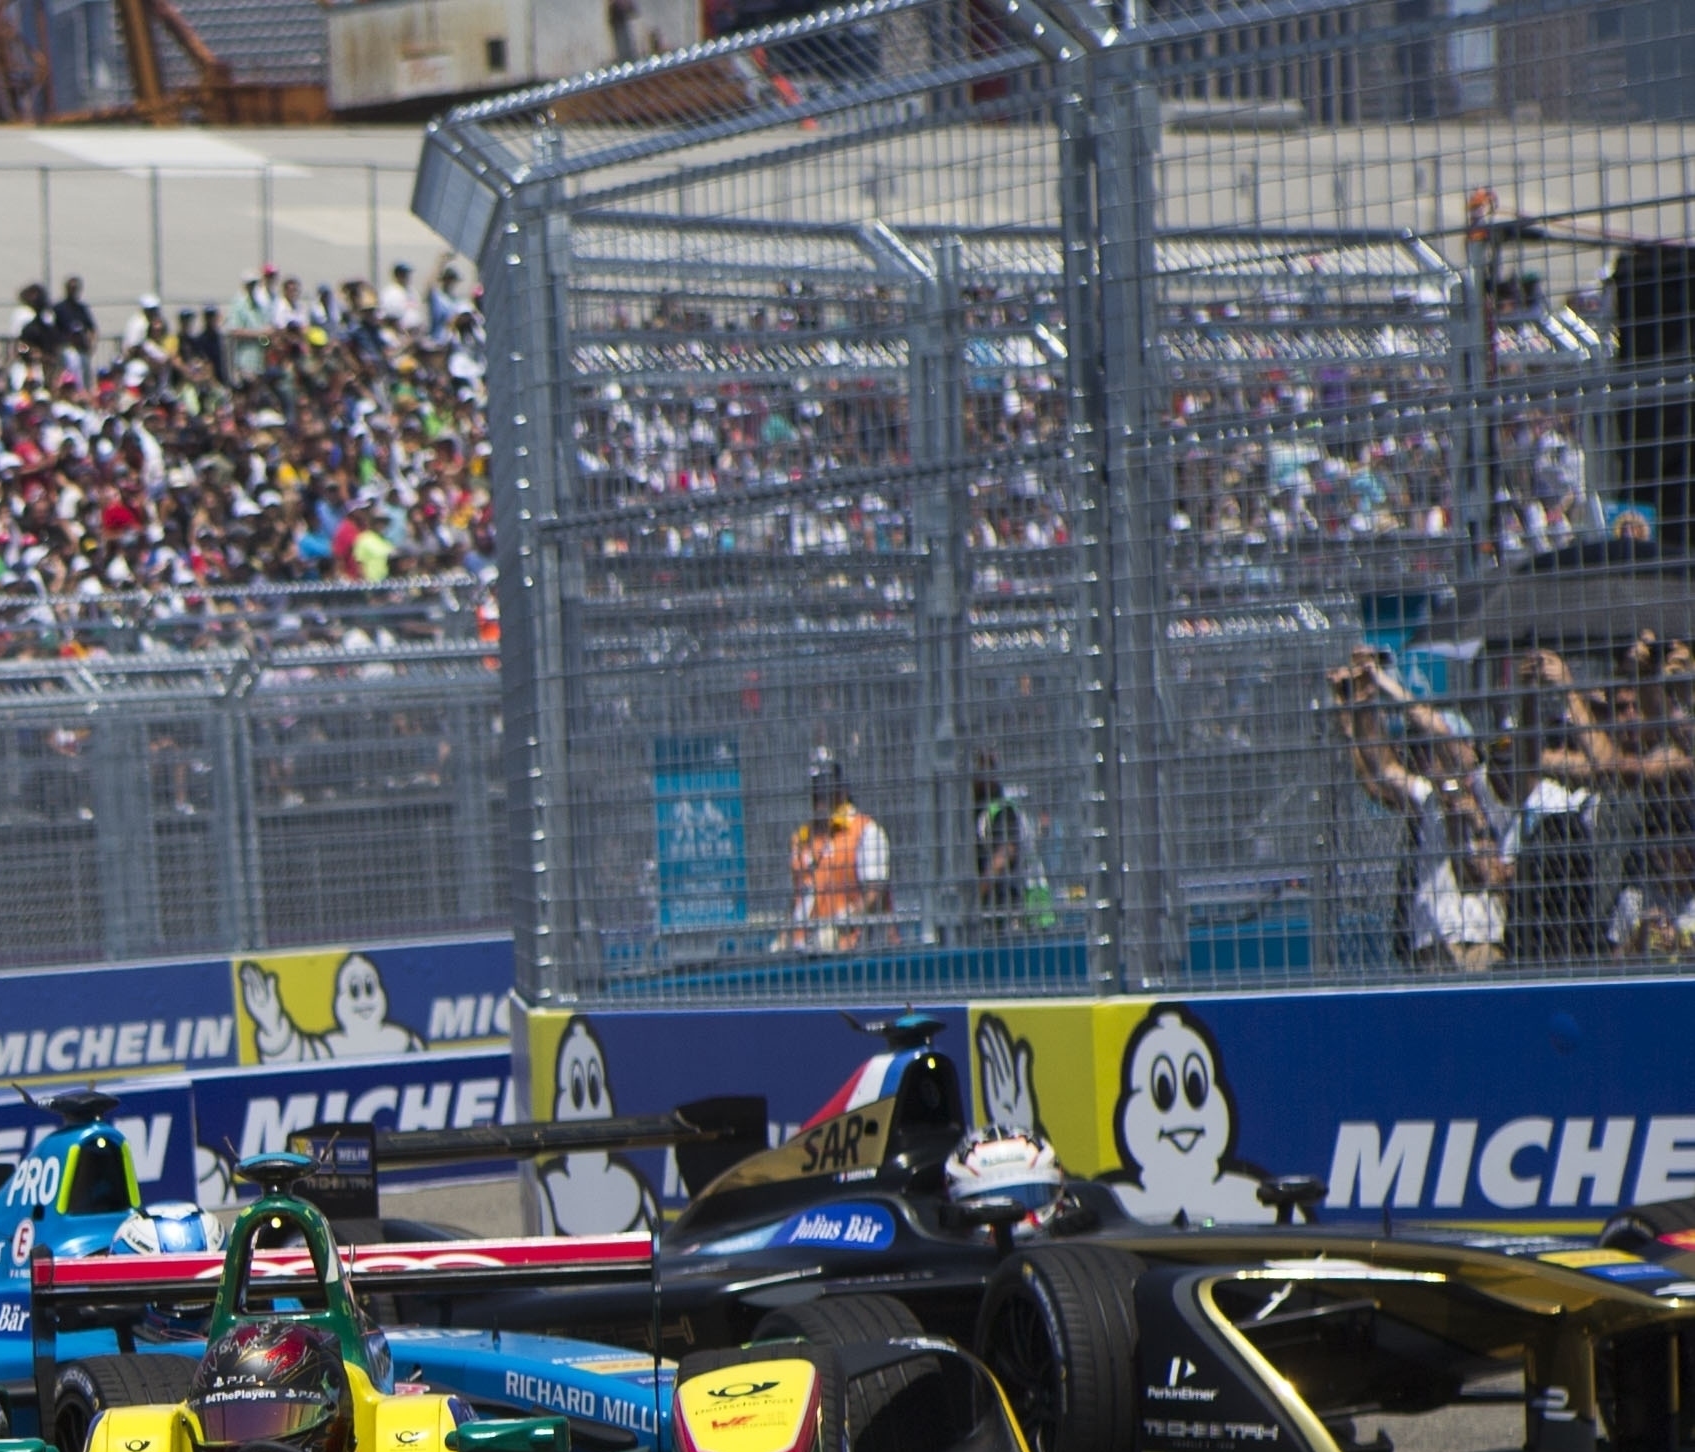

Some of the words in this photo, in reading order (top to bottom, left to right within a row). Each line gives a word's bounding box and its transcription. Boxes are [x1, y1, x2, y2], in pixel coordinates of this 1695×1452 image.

[6, 1155, 60, 1207] PRO
[1325, 1115, 1695, 1210] MICHE
[788, 1213, 841, 1243] Julius
[842, 1214, 884, 1245] Bär
[504, 1370, 598, 1419] RICHARD
